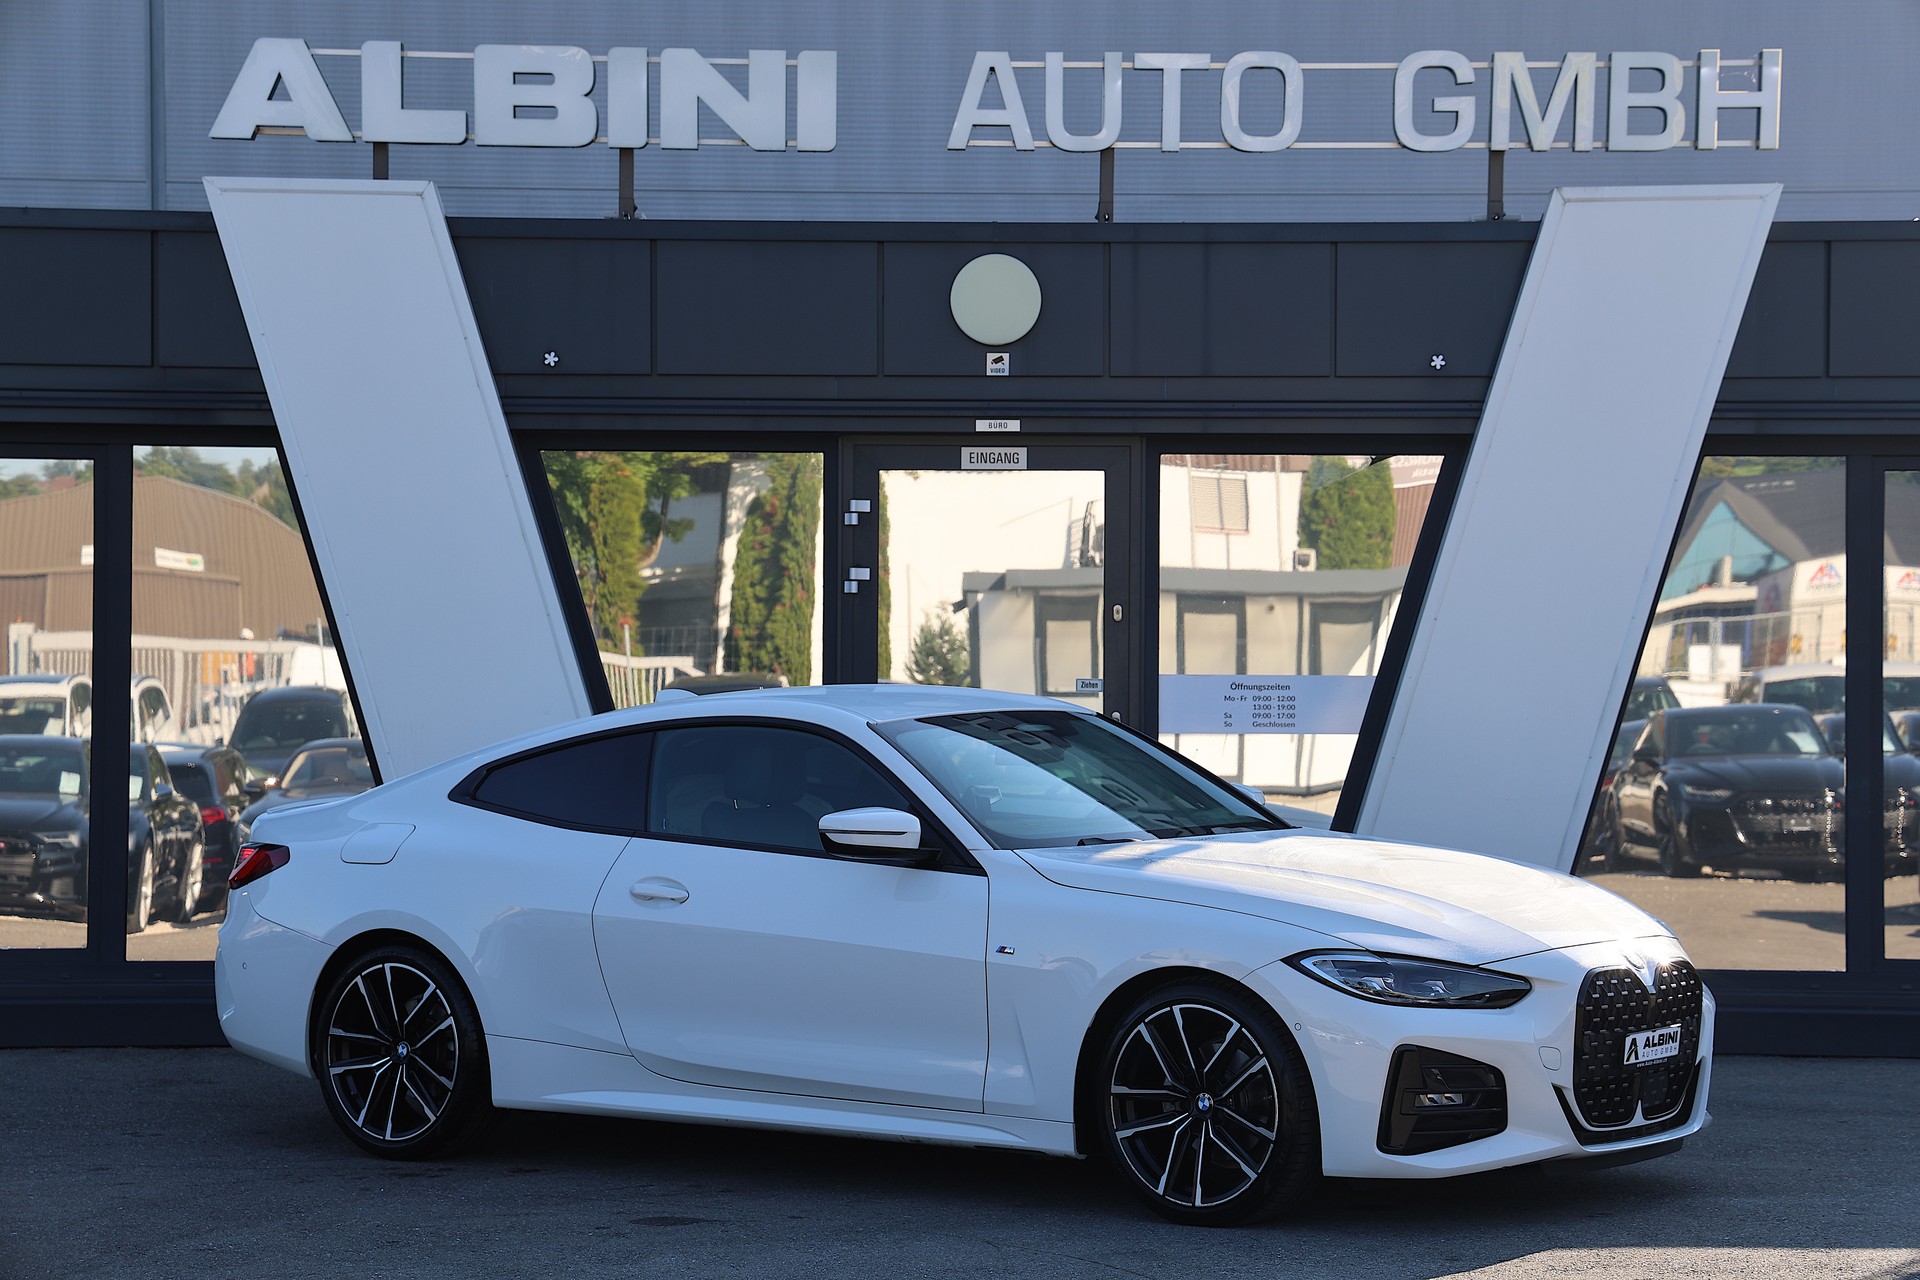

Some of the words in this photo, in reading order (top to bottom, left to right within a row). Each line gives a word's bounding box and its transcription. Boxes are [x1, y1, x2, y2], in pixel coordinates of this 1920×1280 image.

[208, 37, 837, 152] ALBINI
[947, 50, 1303, 153] AUTO
[1393, 48, 1783, 152] GMBH
[988, 421, 1008, 429] BÜRO
[969, 452, 1020, 464] EINGANG
[1230, 682, 1291, 692] Öffnungszeiten
[1223, 720, 1233, 728] So
[1643, 1031, 1678, 1049] ALBINI
[1642, 1049, 1658, 1058] AUTO
[1660, 1045, 1677, 1055] GMBH
